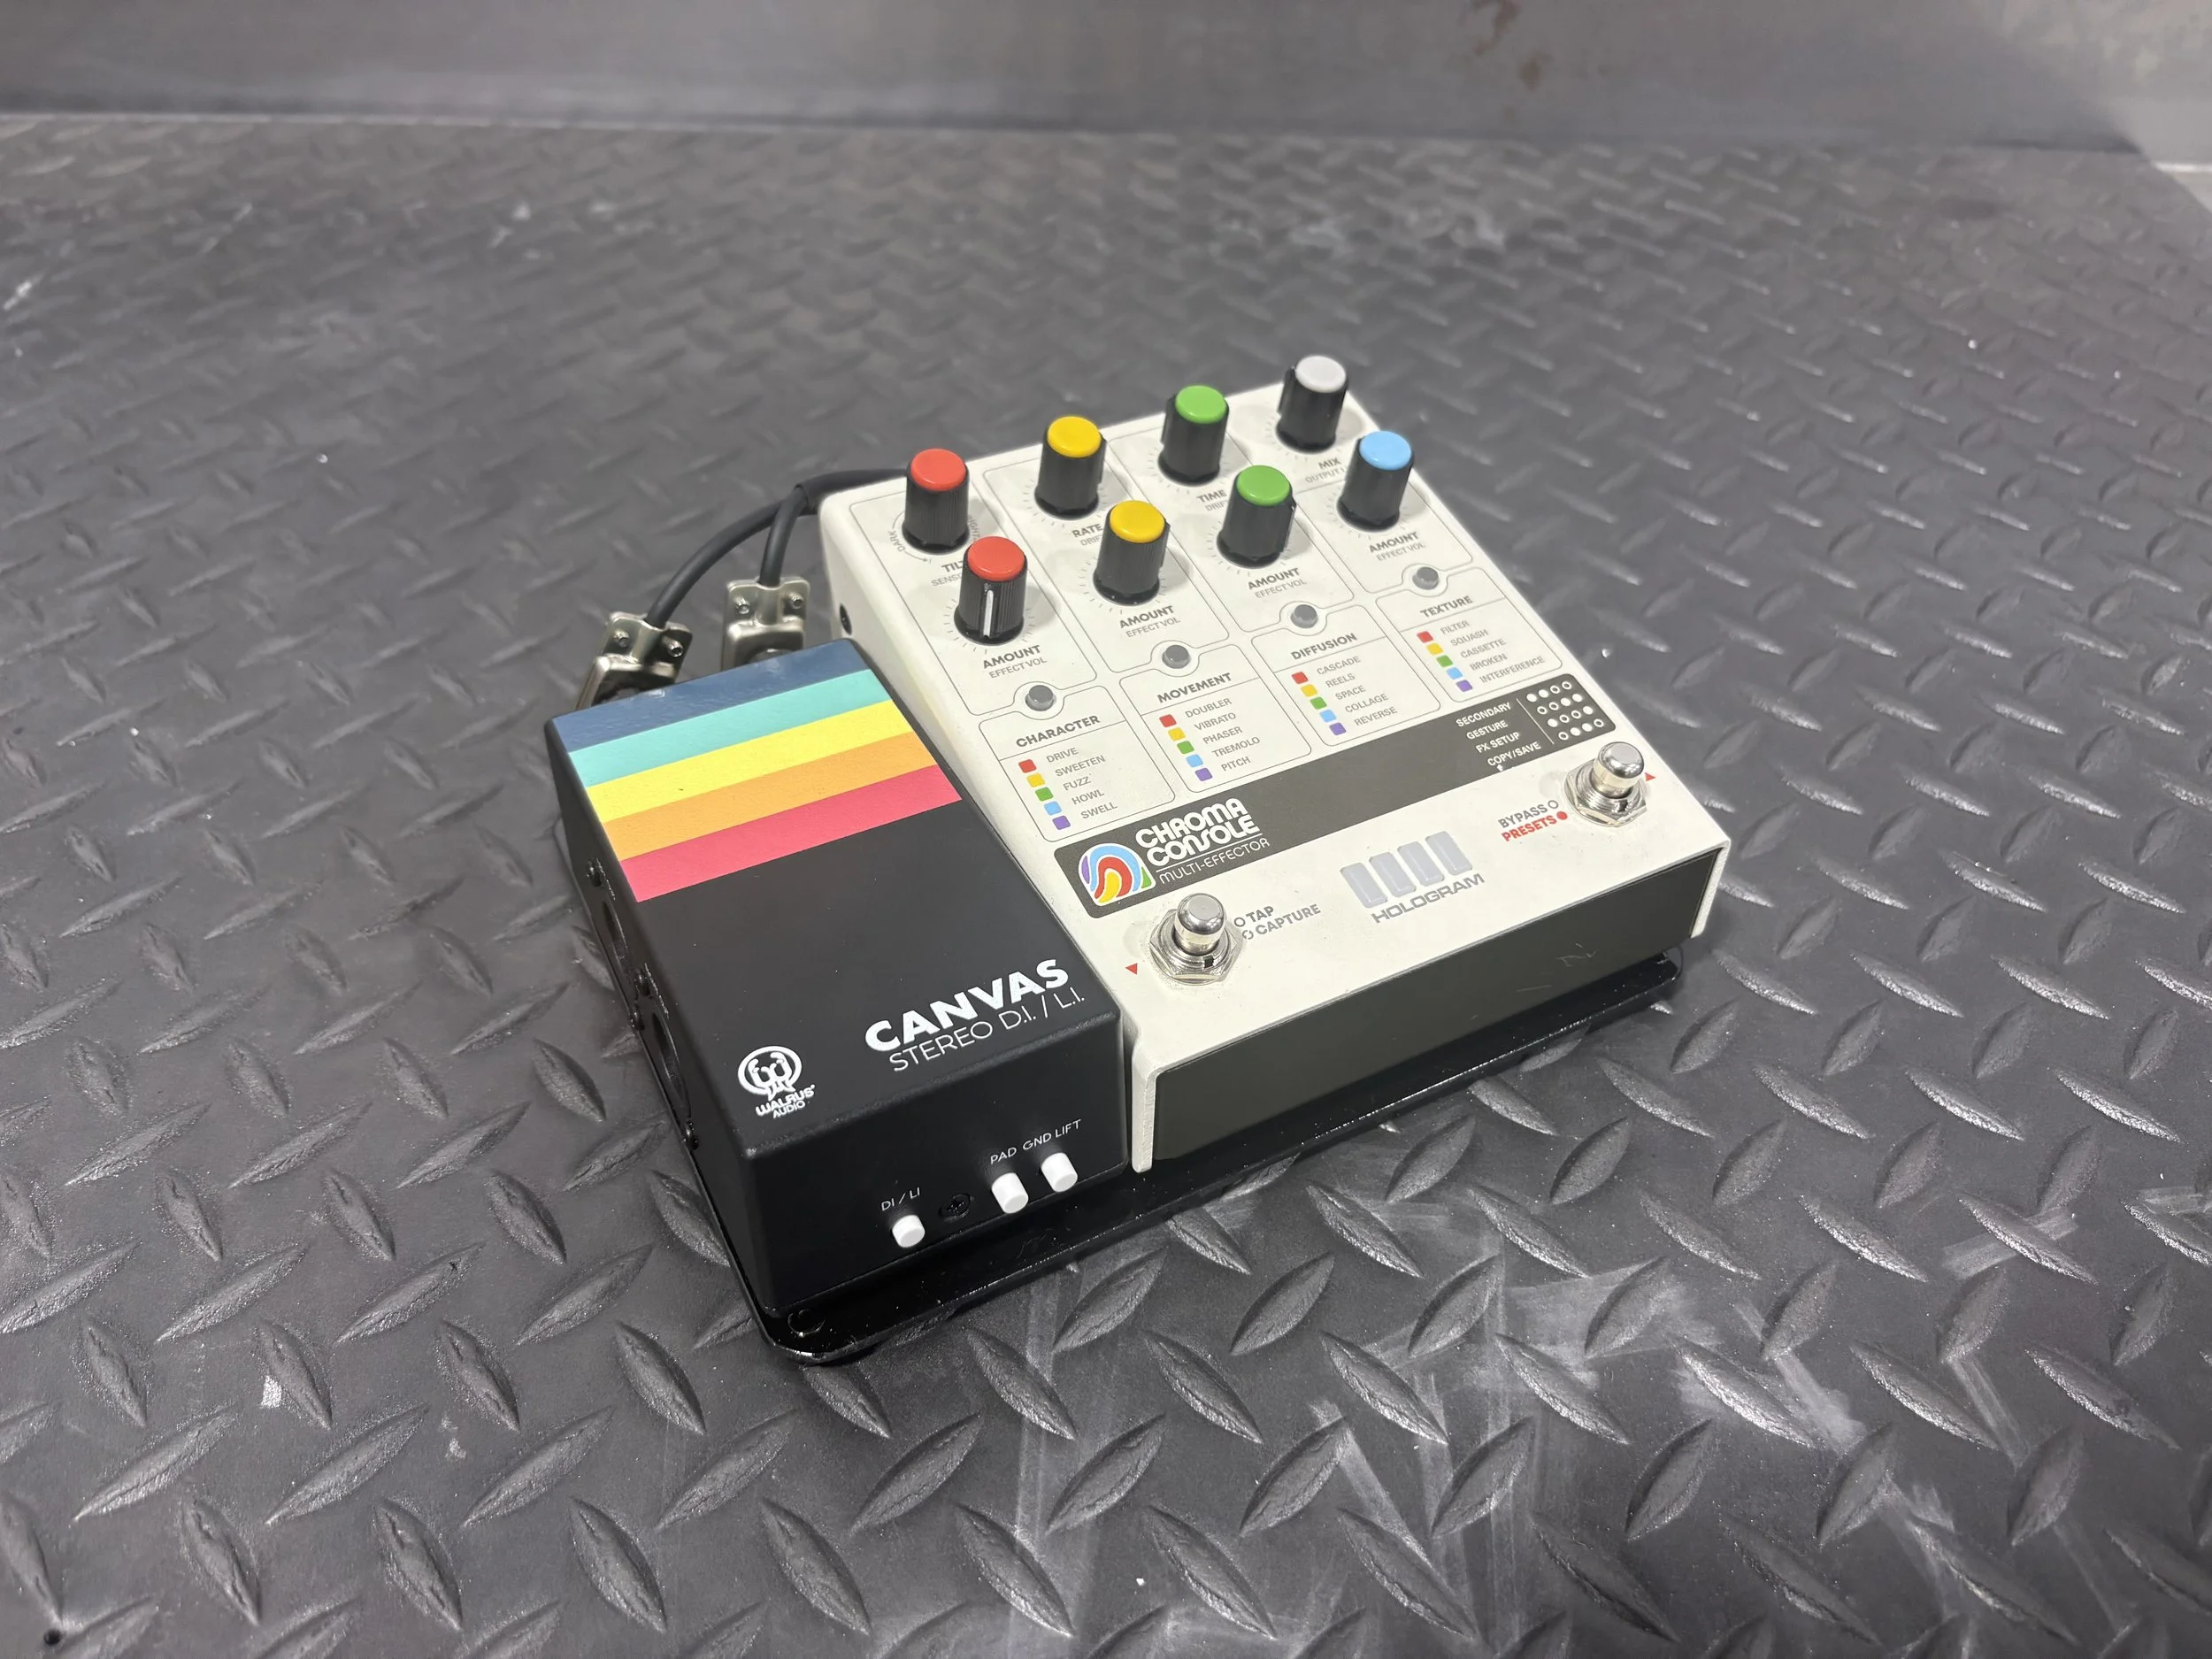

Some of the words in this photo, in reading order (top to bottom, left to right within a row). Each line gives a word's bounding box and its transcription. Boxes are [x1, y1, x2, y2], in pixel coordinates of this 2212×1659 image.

[1317, 457, 1341, 470] MIX
[1196, 489, 1227, 503] TIME
[888, 530, 906, 552] DARK
[1071, 524, 1103, 537] RATE
[1370, 531, 1418, 553] AMOUNT
[1376, 547, 1407, 561] EFFECT
[1406, 542, 1426, 551] VOL
[1248, 567, 1300, 590] AMOUNT
[1255, 584, 1287, 598] EFFECT
[1286, 579, 1307, 588] VOL
[1119, 605, 1174, 628] AMOUNT
[1420, 595, 1473, 618] TEXTURE
[1125, 622, 1160, 637] EFFECT
[1159, 618, 1181, 626] VOL
[1440, 620, 1470, 634] FILTER
[1450, 629, 1488, 646] SQUASH
[983, 644, 1041, 669] AMOUNT
[1291, 633, 1357, 660] DIFFUSION
[1460, 639, 1507, 658] CASSETTE
[989, 663, 1025, 678] EFFECT
[1025, 657, 1048, 667] VOL
[1317, 656, 1361, 675] CASCADE
[1470, 653, 1508, 671] BROKEN
[1479, 656, 1545, 683] INTERFERENCE
[1157, 672, 1232, 703] MOVEMENT
[1325, 673, 1356, 687] REELS
[1335, 685, 1366, 700] SPACE
[1344, 693, 1389, 713] COLLAGE
[1185, 698, 1232, 718] DOUBLER
[1354, 706, 1398, 726] REVERSE
[1456, 702, 1512, 727] SECONDARY
[1016, 715, 1101, 748] CHARACTER
[1194, 712, 1236, 731] VIBRATO
[1466, 720, 1508, 740] GESTURE
[1202, 726, 1243, 744] PHASER
[1475, 743, 1491, 753] FX
[1489, 732, 1520, 749] SETUP
[1046, 748, 1079, 763] DRIVE
[1211, 736, 1260, 757] TREMOLO
[1487, 741, 1541, 766] COPY/SAVE
[1055, 755, 1106, 777] SWEETEN
[1221, 756, 1251, 772] PITCH
[1063, 776, 1091, 791] FUZZ
[1071, 789, 1105, 805] HOWL
[1081, 803, 1118, 819] SWELL
[1498, 804, 1548, 828] BYPASS
[1135, 798, 1248, 849] CHROMA
[1501, 815, 1557, 841] PRESETS
[1147, 814, 1260, 866] CONSOLE
[1159, 837, 1271, 884] MULTI-EFFECTOR
[1371, 873, 1485, 924] HOLOGRAM
[1246, 906, 1274, 923] TAP
[1256, 903, 1321, 935] CAPTURE
[864, 959, 1069, 1051] CANVAS
[889, 1021, 993, 1071] STEREO
[998, 1005, 1036, 1030] D.I.
[1053, 987, 1085, 1008] L.I.
[755, 1087, 814, 1116] WALRUS
[773, 1100, 805, 1118] AUDIO
[1022, 1133, 1052, 1150] GND
[1055, 1118, 1081, 1138] LIFT
[990, 1147, 1018, 1164] PAD
[881, 1198, 895, 1210] DI
[910, 1187, 920, 1199] LI
